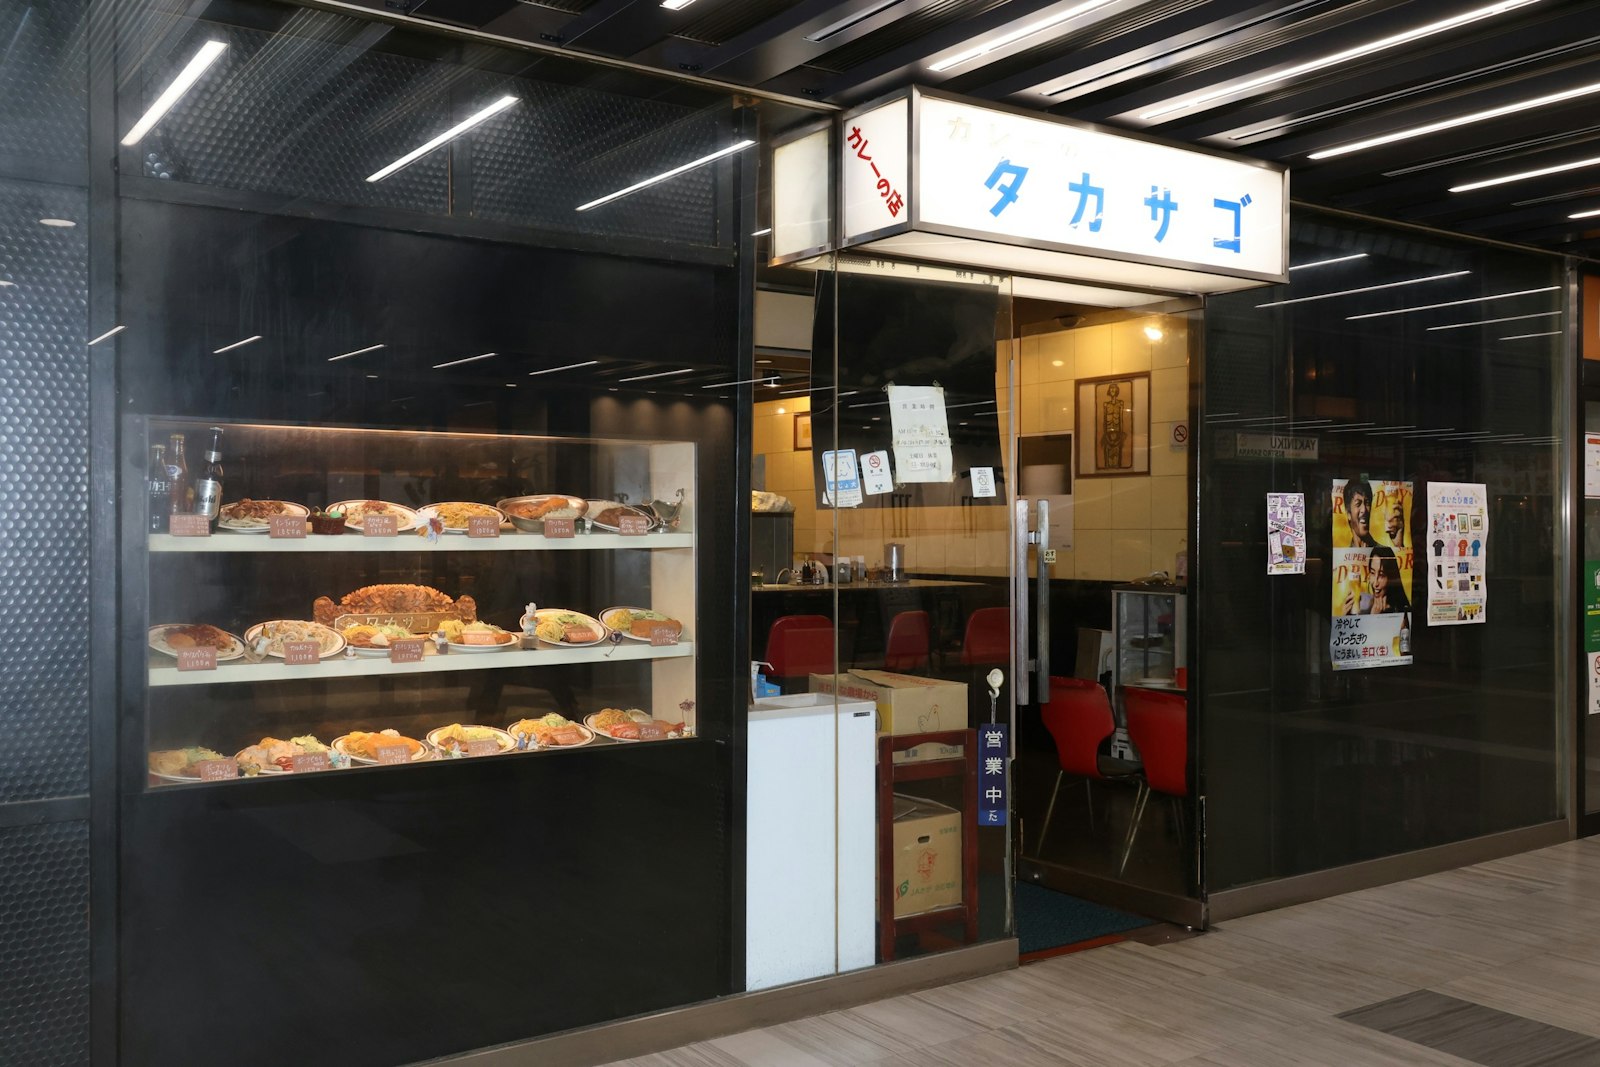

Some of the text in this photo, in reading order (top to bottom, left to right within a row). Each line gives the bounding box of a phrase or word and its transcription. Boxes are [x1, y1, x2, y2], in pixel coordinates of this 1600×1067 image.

[847, 126, 904, 218] カレーの店
[984, 156, 1253, 254] タカサゴ
[1344, 553, 1367, 562] SUPER
[1333, 631, 1368, 646] ぶっちぎり
[1335, 618, 1361, 629] 冷やして
[985, 730, 1003, 804] 営業中
